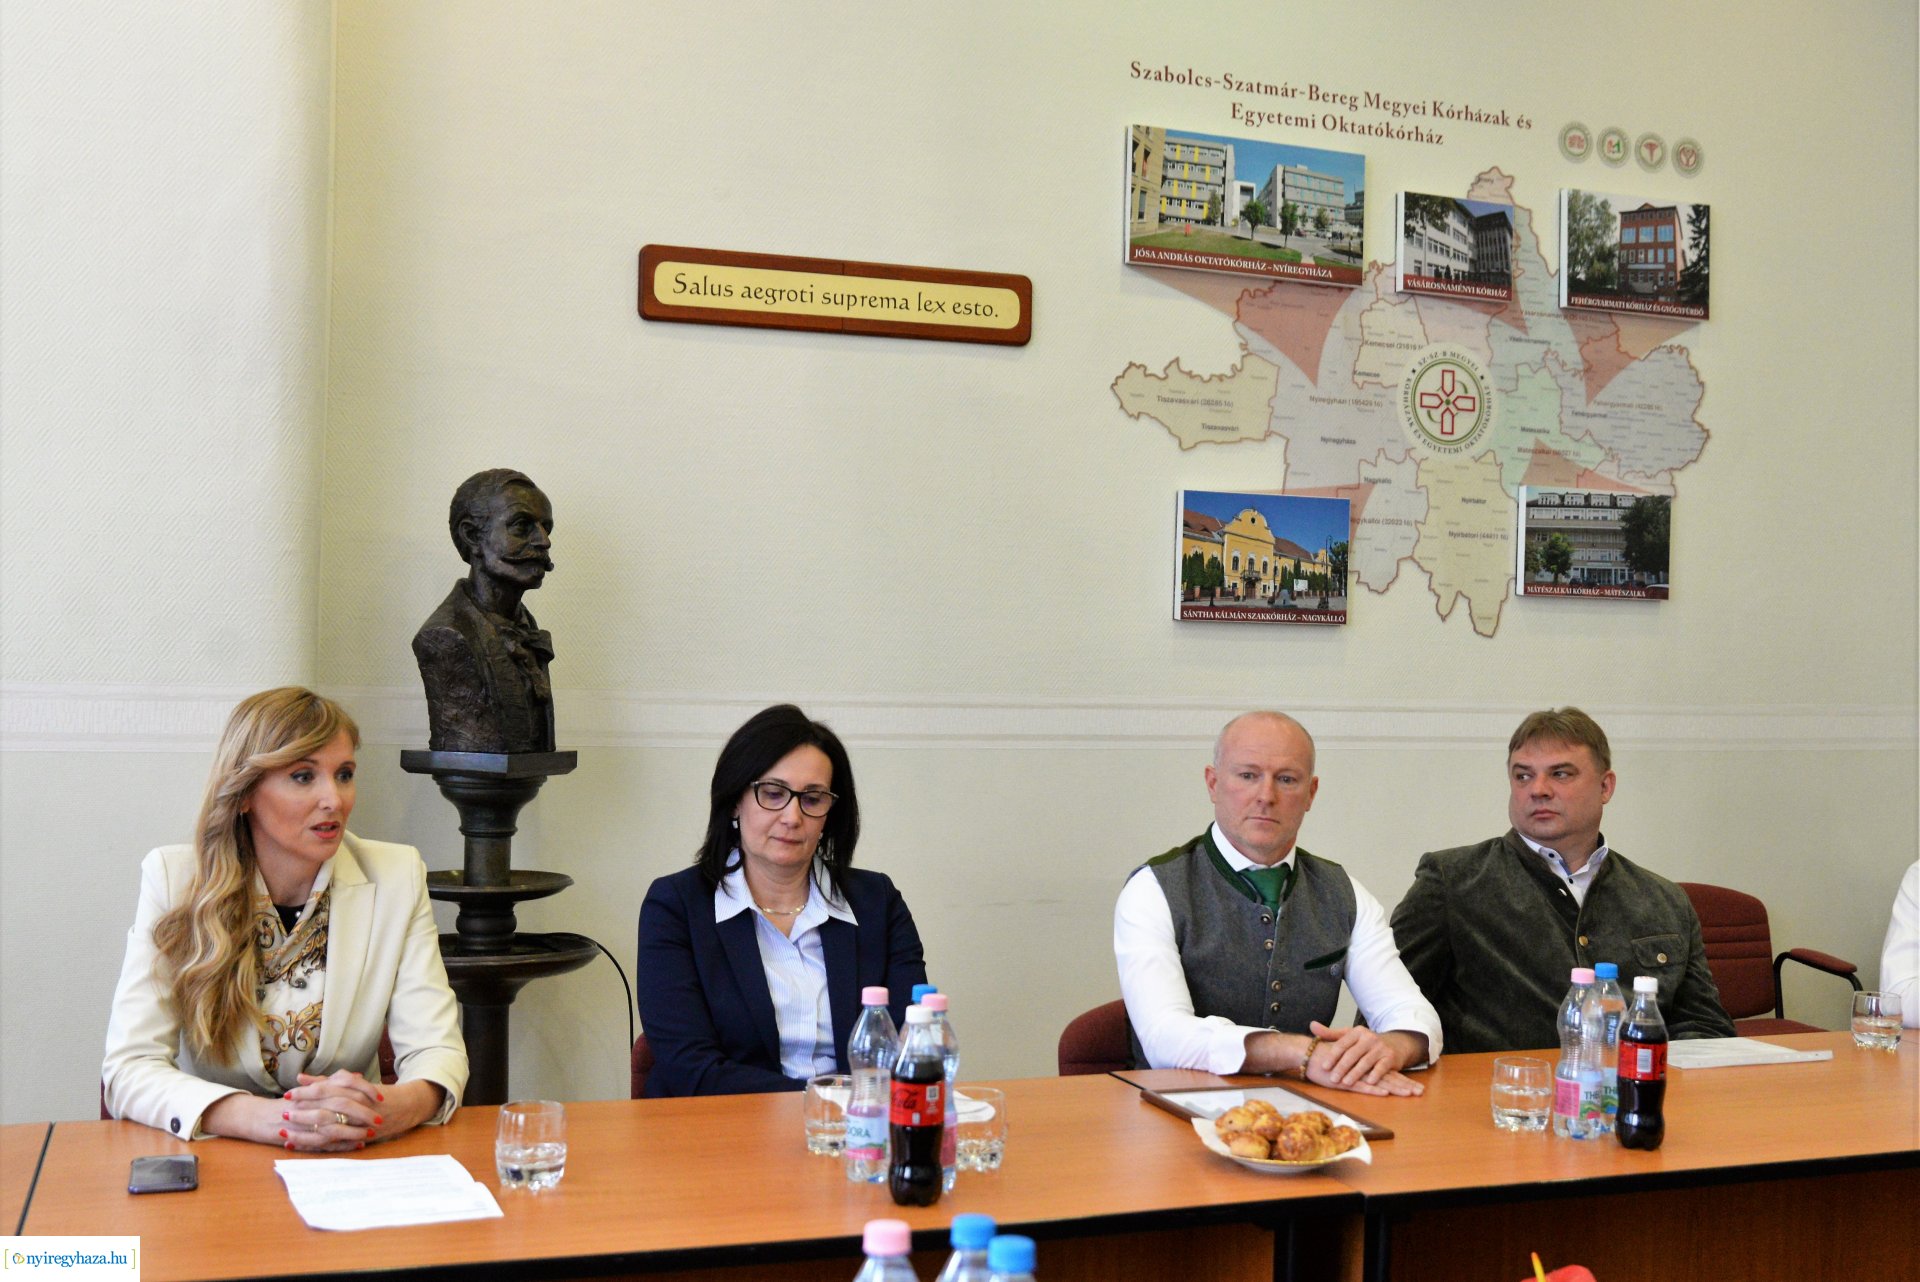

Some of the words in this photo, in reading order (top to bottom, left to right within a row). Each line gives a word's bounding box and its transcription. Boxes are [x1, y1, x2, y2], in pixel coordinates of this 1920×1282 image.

[1130, 60, 1359, 112] Szabolcs-Szatmár-Bereg
[1363, 91, 1427, 118] Megyei
[1431, 100, 1510, 127] Kórházak
[1517, 113, 1533, 130] és
[1230, 102, 1317, 129] Egyetemi
[1322, 115, 1445, 145] Oktatókórház
[1134, 248, 1156, 260] JÓSA
[1157, 251, 1194, 263] ANDRÁS
[1195, 255, 1267, 271] OKTATÓKÓRHÁZ
[1273, 264, 1333, 279] NYÍREGYHÁZA
[672, 272, 735, 298] Salus
[740, 284, 815, 305] aegroti
[821, 291, 910, 312] suprema
[917, 291, 947, 314] lex
[952, 300, 999, 319] esto.
[1407, 279, 1475, 294] VÁSÁROSNAMÉNYI
[1476, 286, 1508, 298] KÓRHÁZ
[1183, 610, 1214, 619] SÁNTHA
[1215, 611, 1247, 620] KÁLMÁN
[1247, 612, 1297, 621] SZAKKÓRHÁZ
[1301, 614, 1345, 623] NAGYKÁLLÓ
